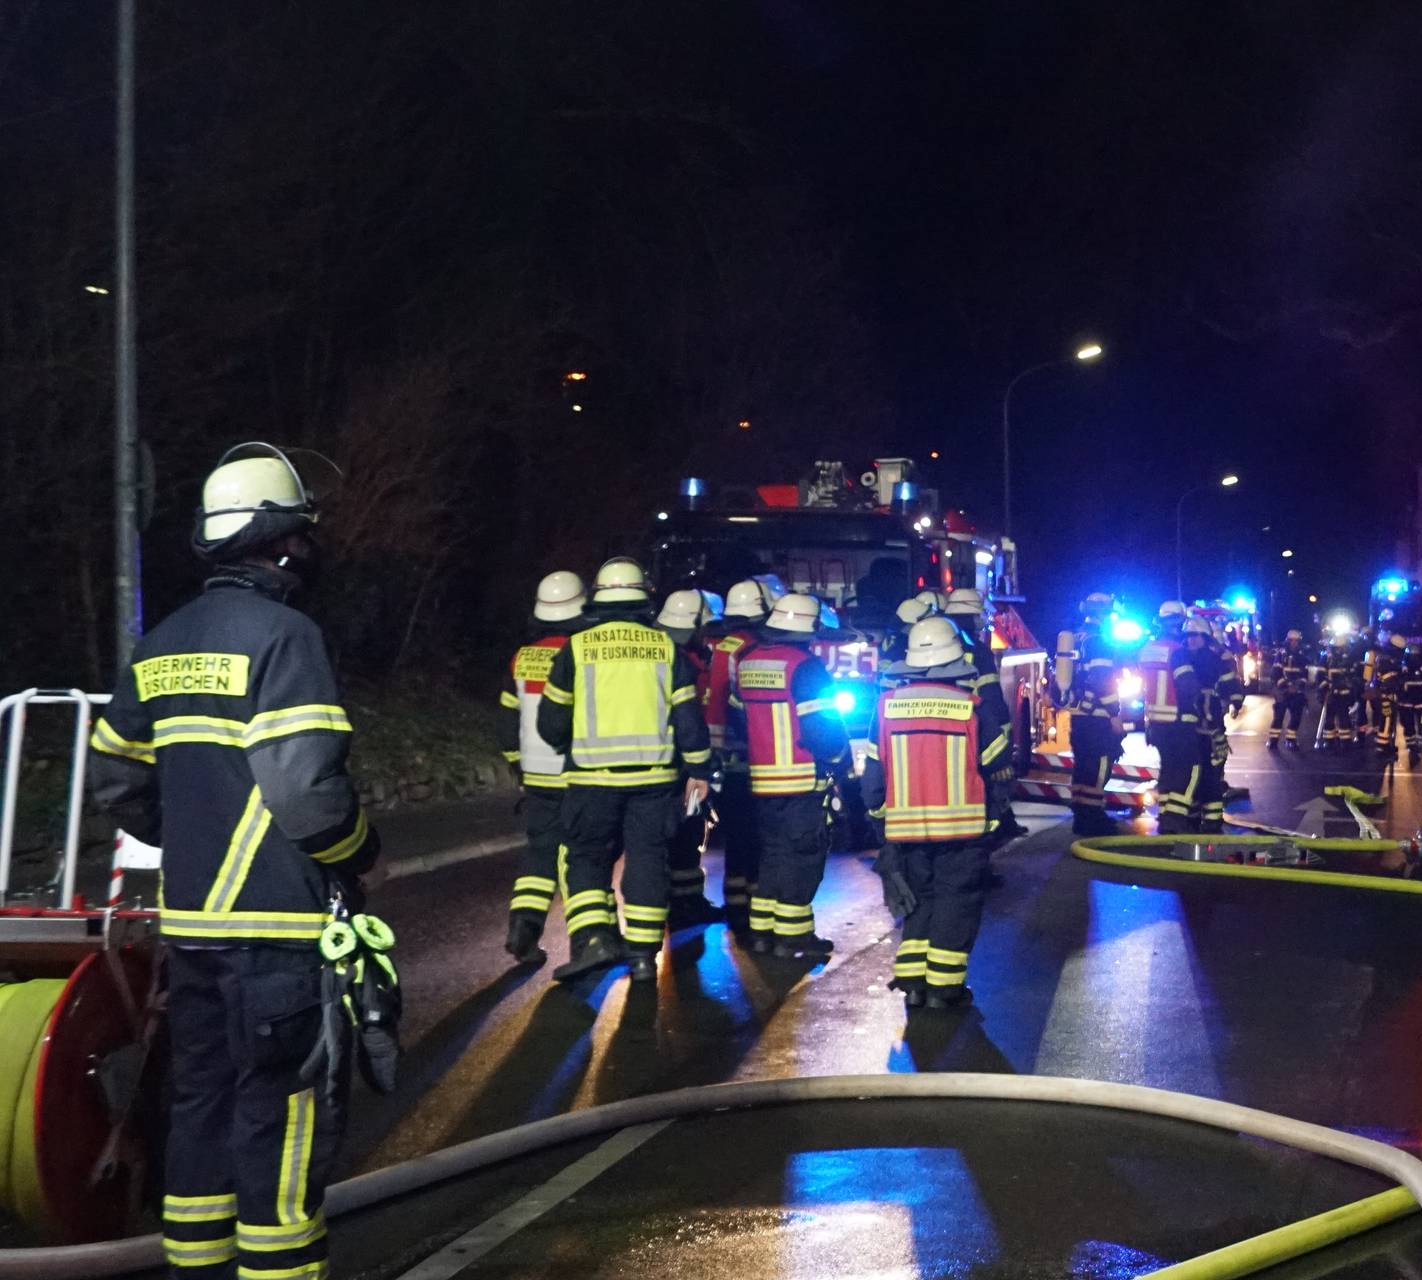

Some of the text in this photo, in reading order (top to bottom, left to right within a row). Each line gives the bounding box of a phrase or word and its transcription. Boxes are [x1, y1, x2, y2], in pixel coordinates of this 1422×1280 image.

[583, 629, 664, 643] EINSATZLEITER
[583, 646, 666, 661] FW EUSKIRCHEN
[142, 657, 231, 678] FEUERWEHR
